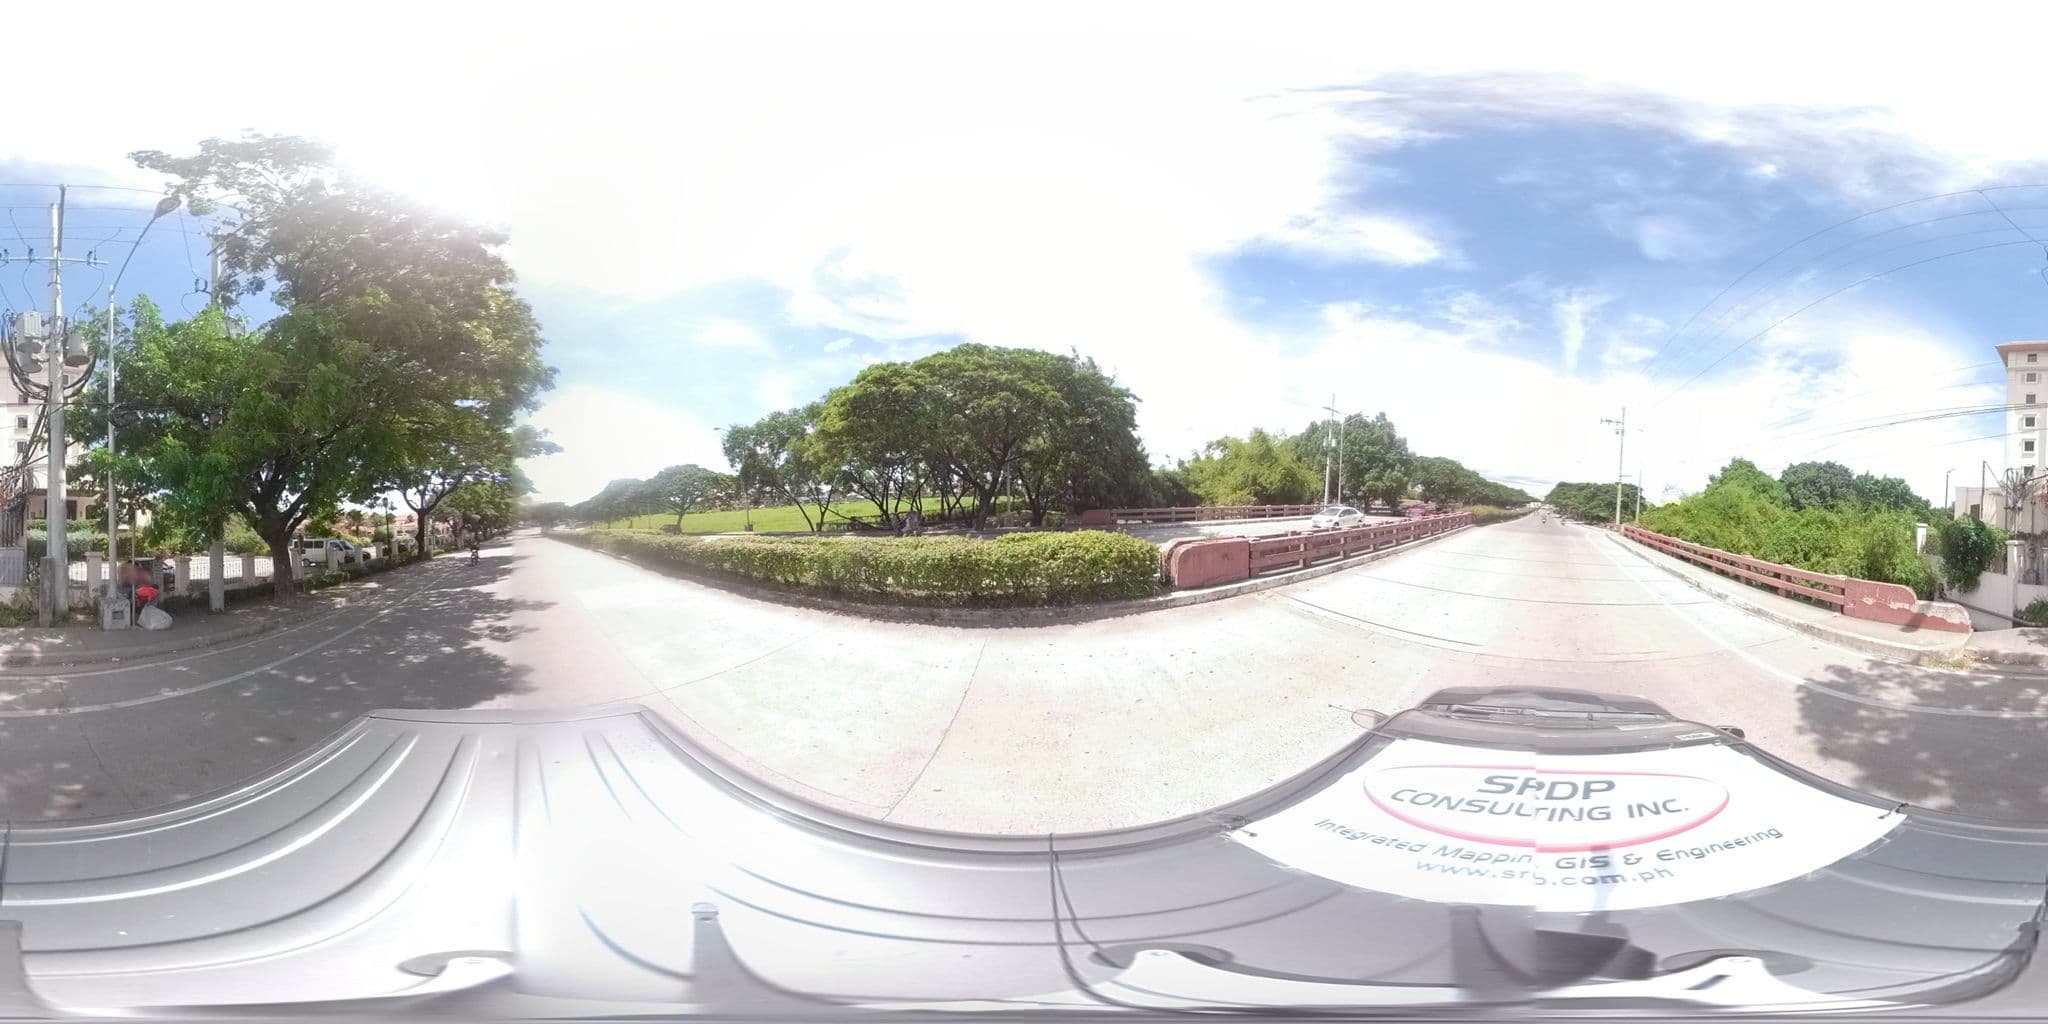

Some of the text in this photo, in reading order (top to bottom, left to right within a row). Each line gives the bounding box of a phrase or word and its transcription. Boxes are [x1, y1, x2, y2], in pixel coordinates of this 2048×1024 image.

[1390, 788, 1690, 822] CONSULTING INC.
[1314, 818, 1783, 870] Integrated Mappin GIS & Engineering
